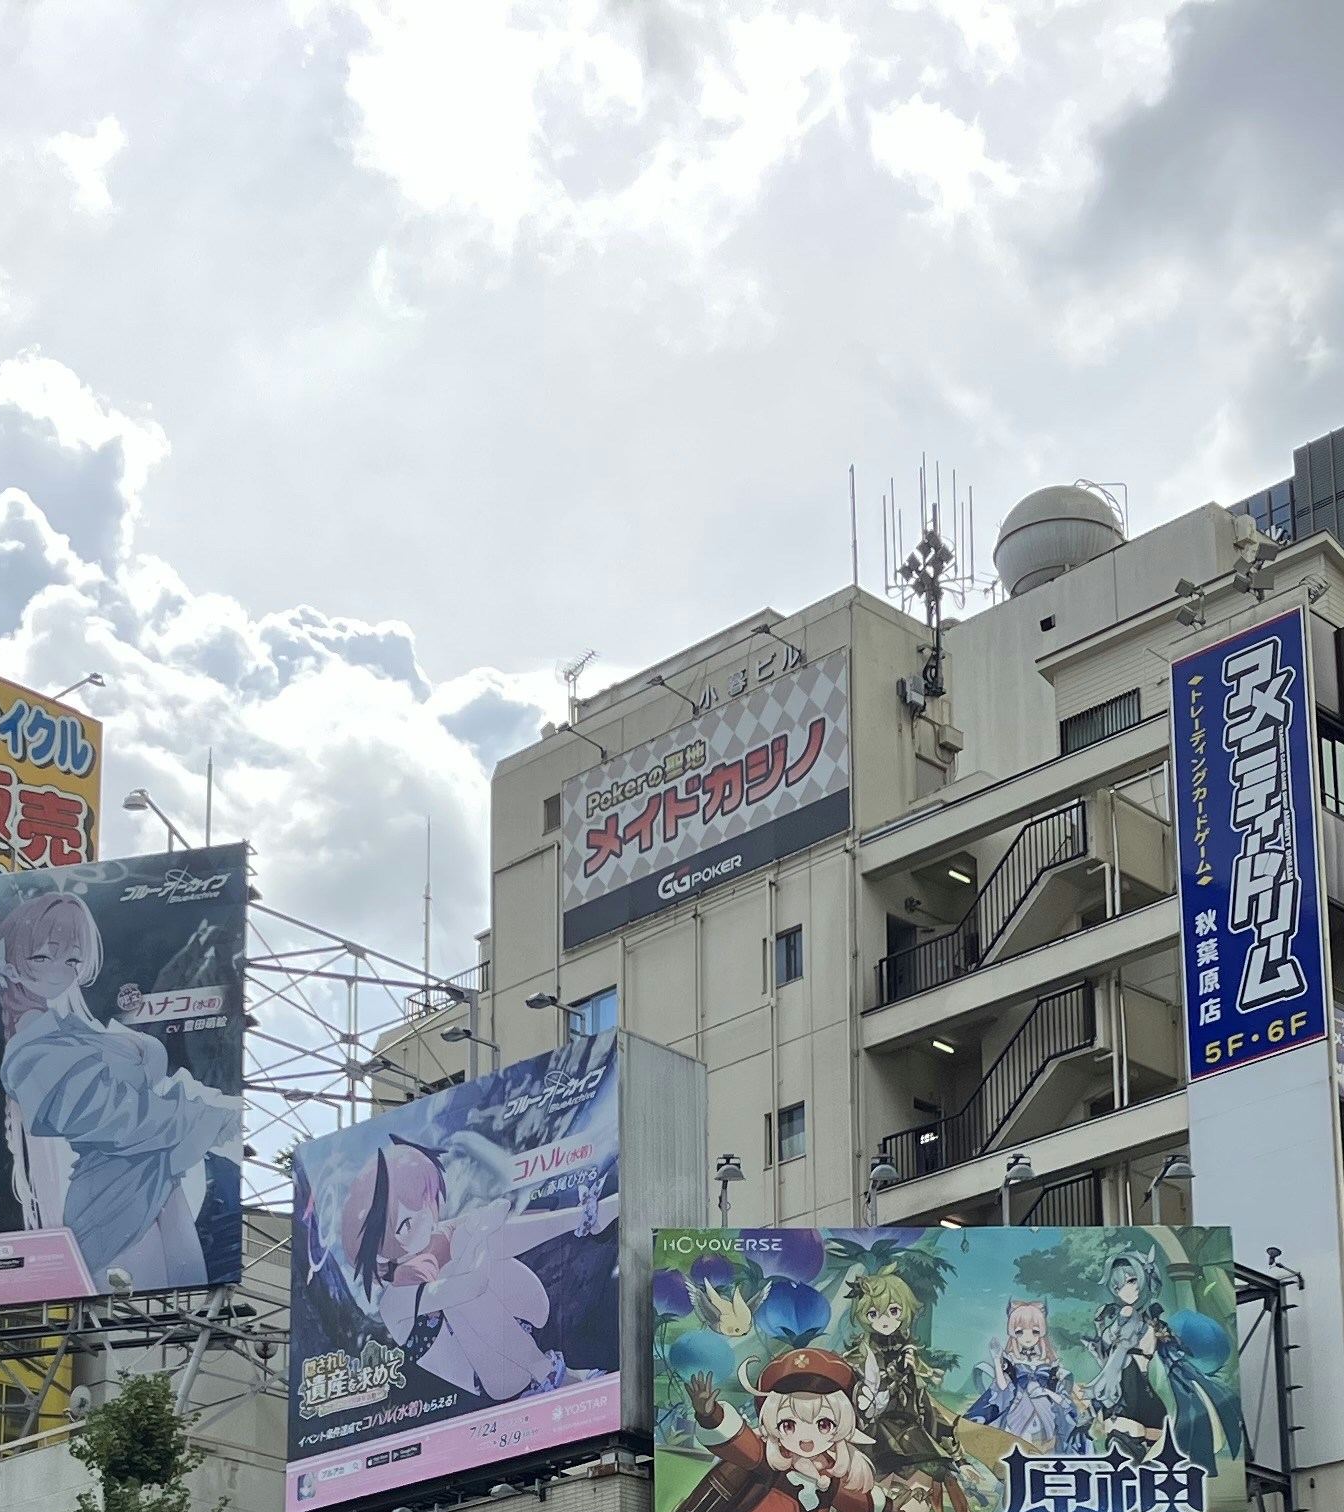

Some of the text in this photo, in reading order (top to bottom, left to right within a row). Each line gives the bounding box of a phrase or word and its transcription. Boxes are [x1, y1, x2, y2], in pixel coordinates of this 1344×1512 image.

[584, 717, 826, 878] メイドカジノ
[1189, 690, 1213, 876] トレーディングカードゲーム
[1195, 908, 1223, 1027] 秋葉原店
[663, 1235, 783, 1254] HOYOVERSE
